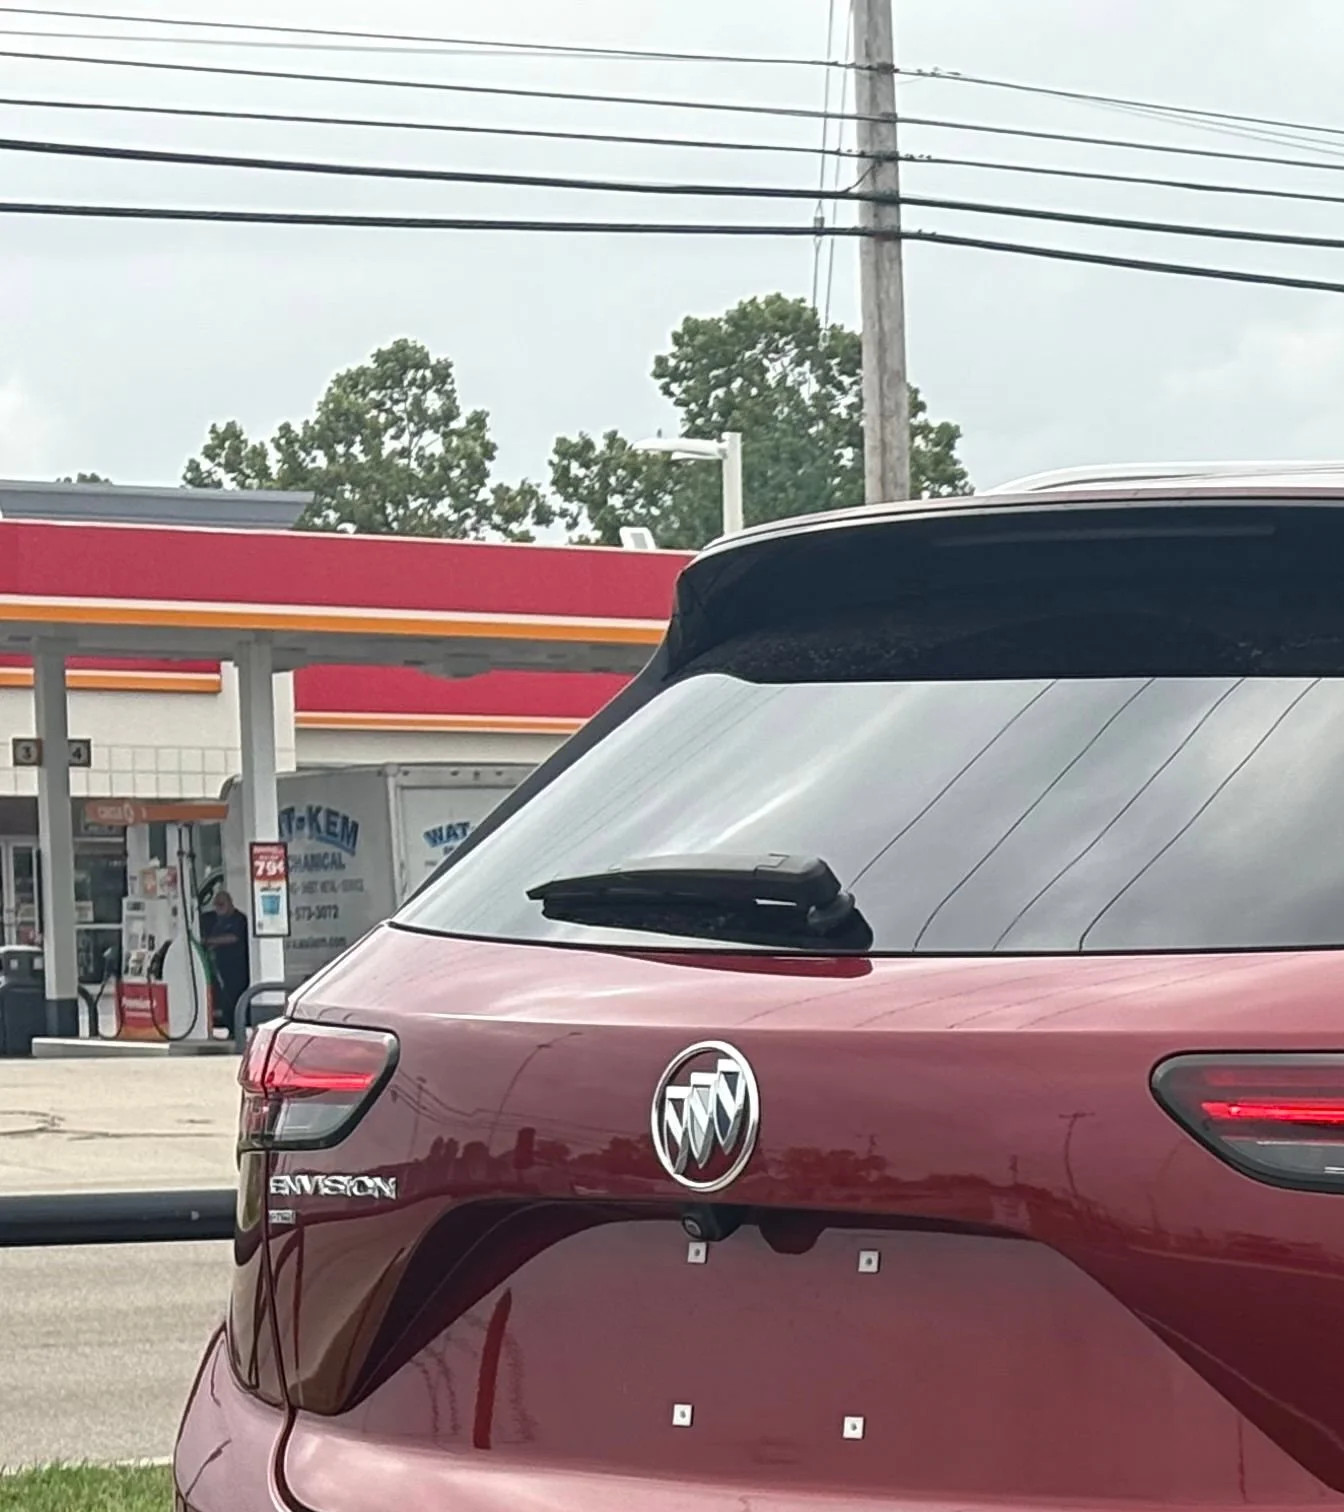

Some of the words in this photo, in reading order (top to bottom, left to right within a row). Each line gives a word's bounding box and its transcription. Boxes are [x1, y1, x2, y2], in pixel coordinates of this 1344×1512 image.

[22, 745, 33, 760] 3
[71, 747, 83, 760] 4
[269, 1174, 397, 1201] ENVISION
